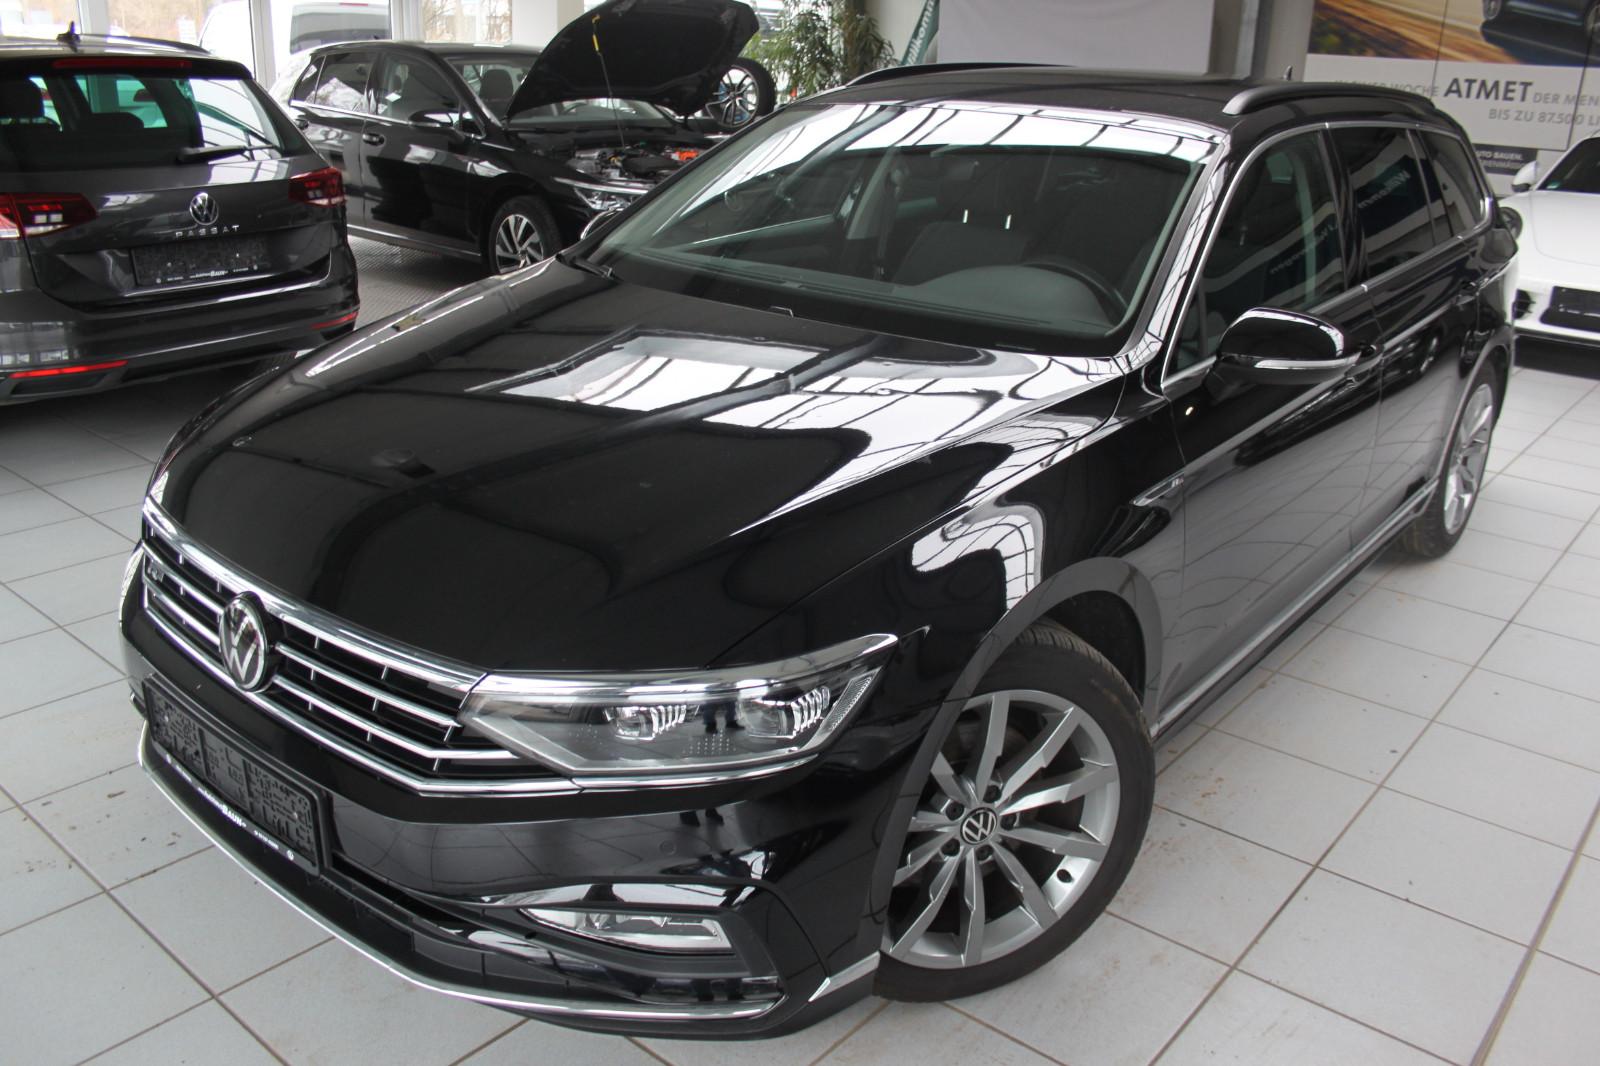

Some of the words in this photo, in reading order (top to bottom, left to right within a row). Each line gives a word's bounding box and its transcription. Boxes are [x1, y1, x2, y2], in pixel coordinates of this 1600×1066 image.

[1443, 77, 1534, 103] ATMET
[1533, 92, 1560, 105] DER
[1488, 108, 1511, 121] BIS
[1513, 110, 1535, 123] ZU
[175, 225, 240, 238] PASSAT
